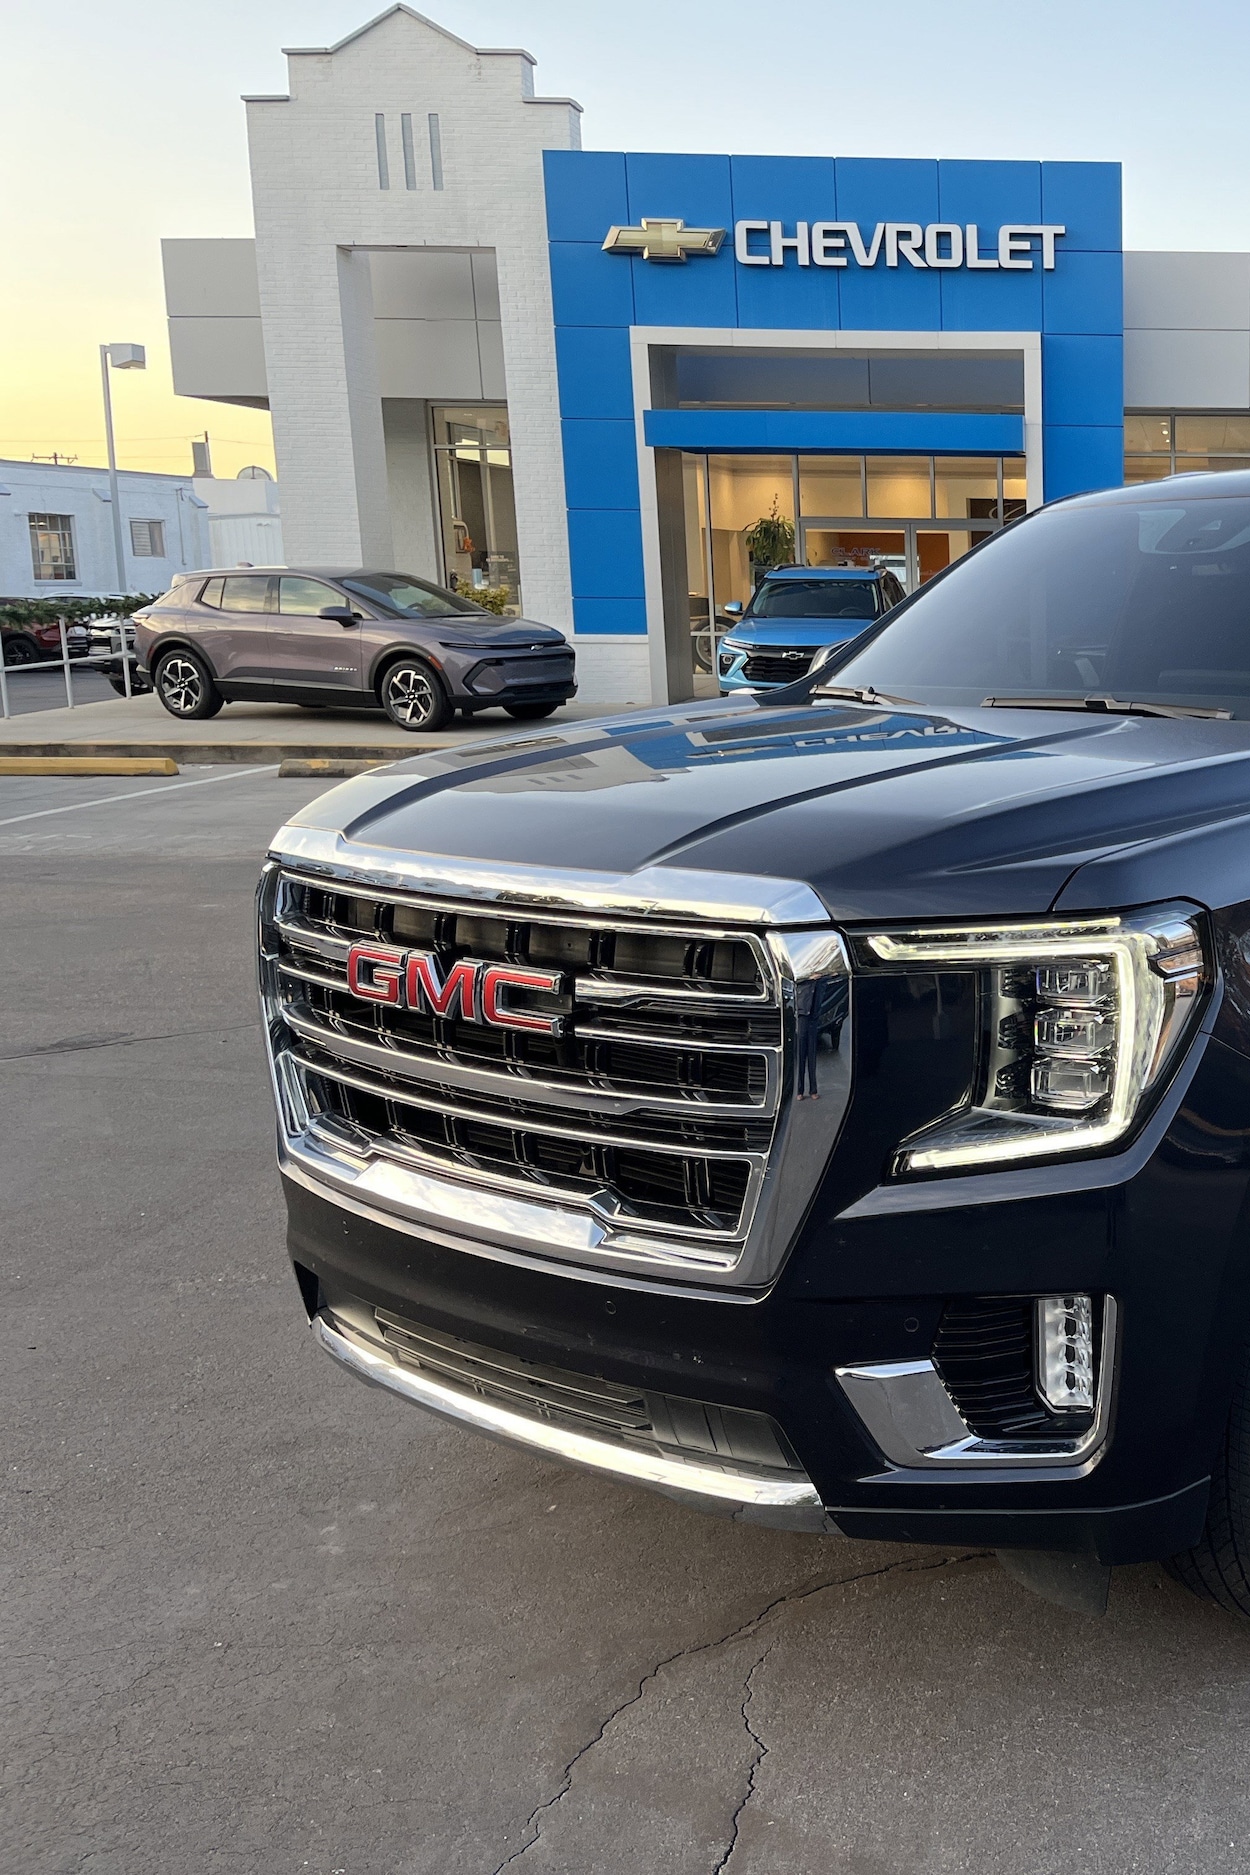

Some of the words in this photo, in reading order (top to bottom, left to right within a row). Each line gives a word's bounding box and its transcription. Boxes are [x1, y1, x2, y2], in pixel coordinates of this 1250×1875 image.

[734, 219, 1066, 270] CHEVROLET
[832, 547, 880, 556] CLARK
[347, 939, 566, 1039] GMC
